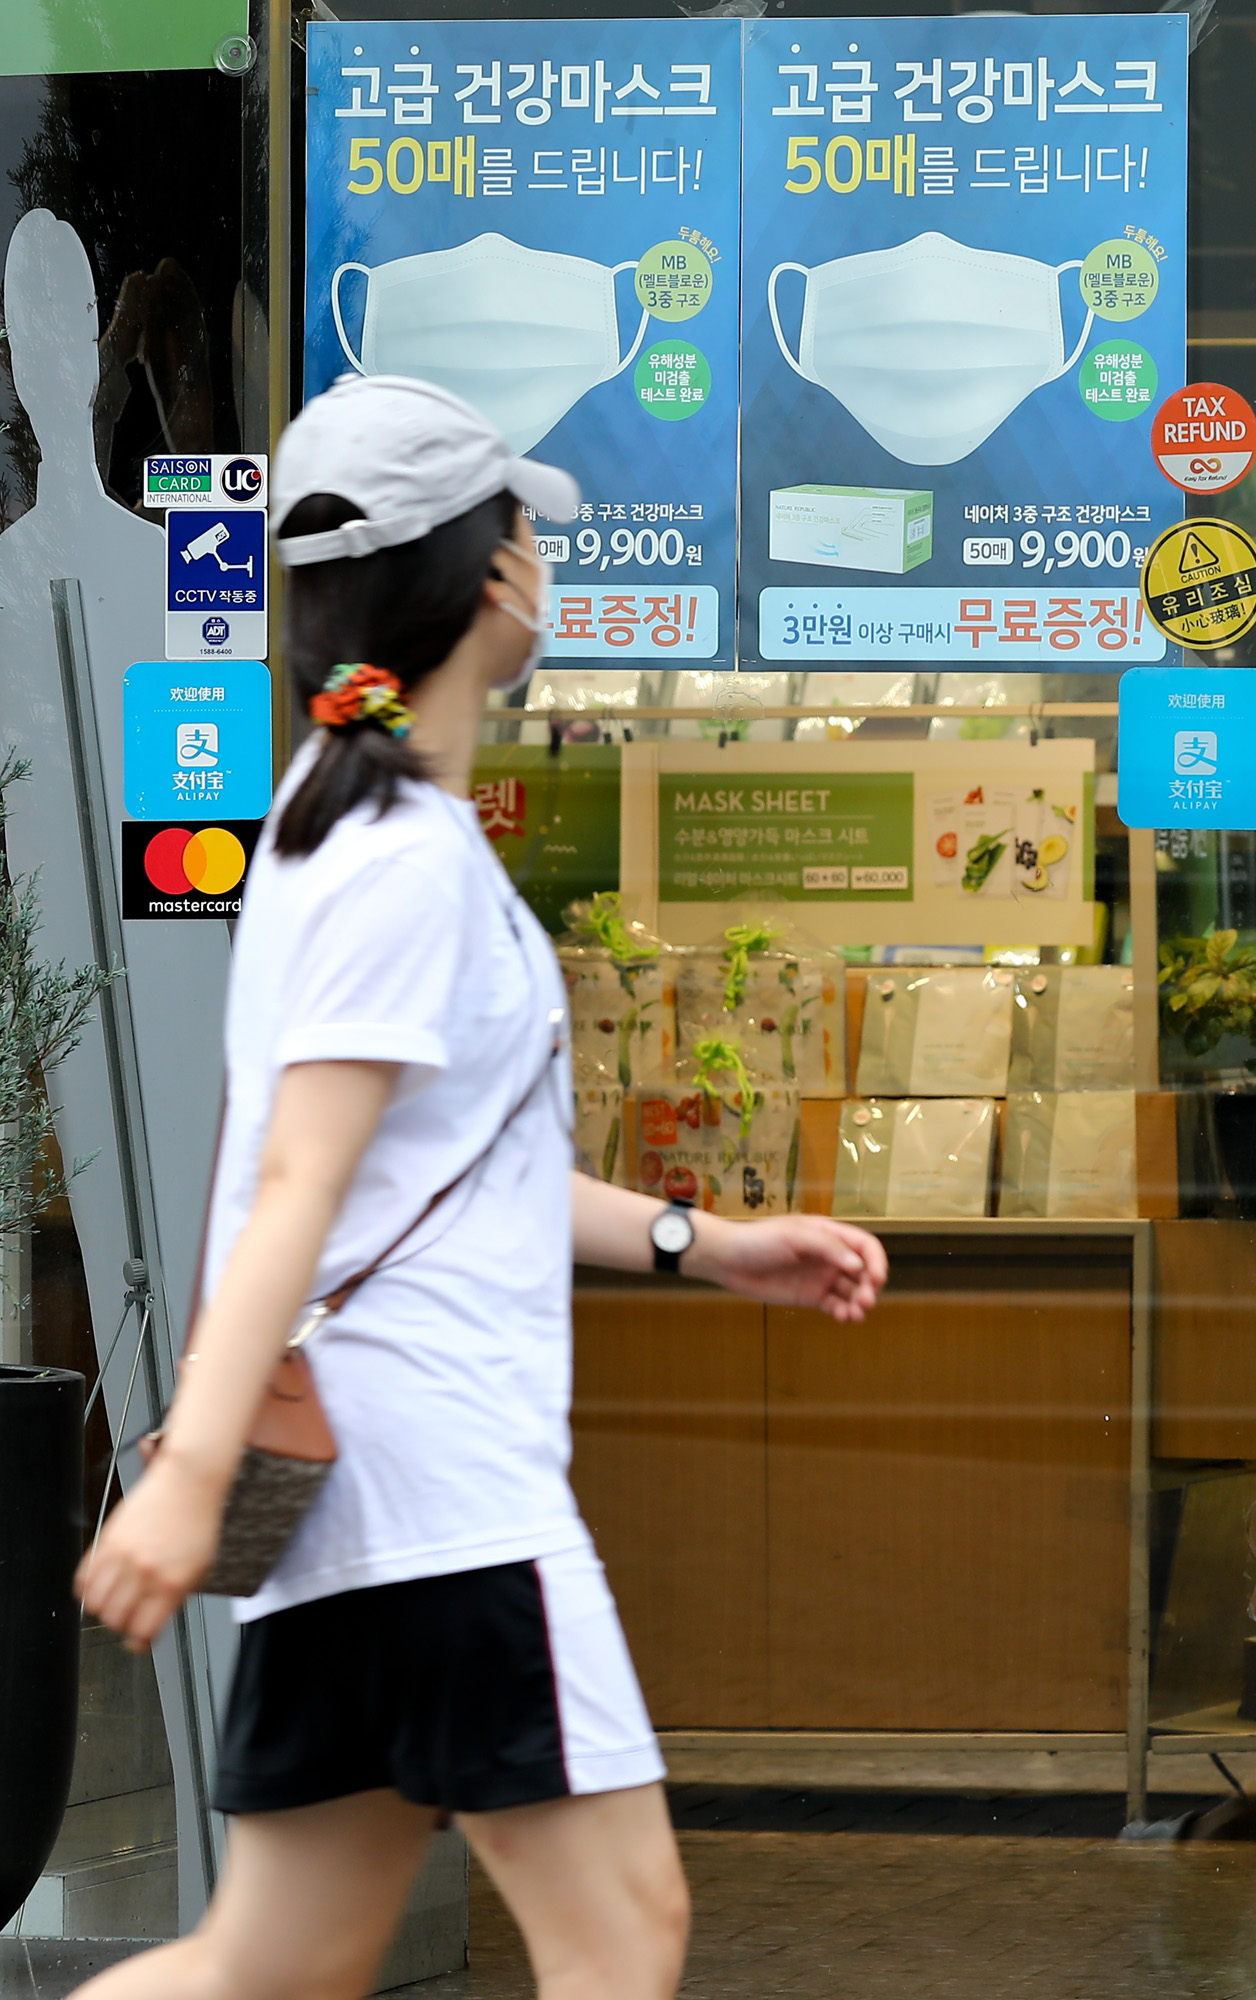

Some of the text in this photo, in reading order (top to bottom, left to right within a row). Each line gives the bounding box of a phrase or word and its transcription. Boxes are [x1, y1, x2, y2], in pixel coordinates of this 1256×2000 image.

[335, 60, 717, 126] 고급 건강마스크
[772, 57, 1163, 124] 고급 건강마스크
[347, 135, 703, 198] 50매를 드립니다!
[784, 133, 1149, 197] 50매를 드립니다!
[678, 226, 722, 263] 두툼해요!
[1123, 225, 1168, 262] 두툼해요!
[662, 255, 687, 270] MB
[1106, 254, 1132, 269] MB
[639, 274, 709, 289] (멜트블로운)
[1084, 273, 1154, 288] (멜트블로운)
[647, 291, 700, 308] 3중 구조
[1092, 290, 1146, 308] 3중 구조
[648, 353, 697, 369] 유해성분
[1093, 353, 1143, 369] 유해성분
[655, 370, 690, 386] 미검출
[1099, 370, 1137, 386] 미검출
[641, 387, 704, 402] 테스트 완료
[1085, 387, 1151, 403] 테스트 완료
[1182, 396, 1226, 418] TAX
[1163, 421, 1247, 443] REFUND
[150, 460, 209, 475] SAISON
[158, 477, 201, 491] CARD
[146, 493, 212, 503] INTERNATIONAL
[597, 504, 626, 521] 구조
[630, 503, 704, 522] 건강마스크
[964, 504, 1151, 523] 네이처 3중 구조 건강마스크
[532, 528, 703, 572] 0매 9,900원
[969, 542, 1007, 560] 50매
[1181, 566, 1221, 583] CAUTION
[175, 590, 257, 603] CCTV 작동중
[546, 594, 698, 647] 료증정!
[1182, 602, 1246, 633] 小心玻璃!
[207, 626, 225, 636] ADT
[782, 614, 852, 645] 3만원
[858, 622, 893, 644] 이상
[170, 687, 225, 702] 欢迎使用
[1168, 694, 1225, 709] 欢迎使用
[172, 771, 224, 790] 支付宝
[177, 792, 220, 801] ALIPAY
[1169, 780, 1222, 799] 支付宝
[674, 789, 831, 812] MASK SHEET
[1173, 801, 1218, 810] ALIPAY
[784, 827, 833, 846] 마스크
[838, 827, 870, 845] 시트
[149, 898, 242, 912] mastercard
